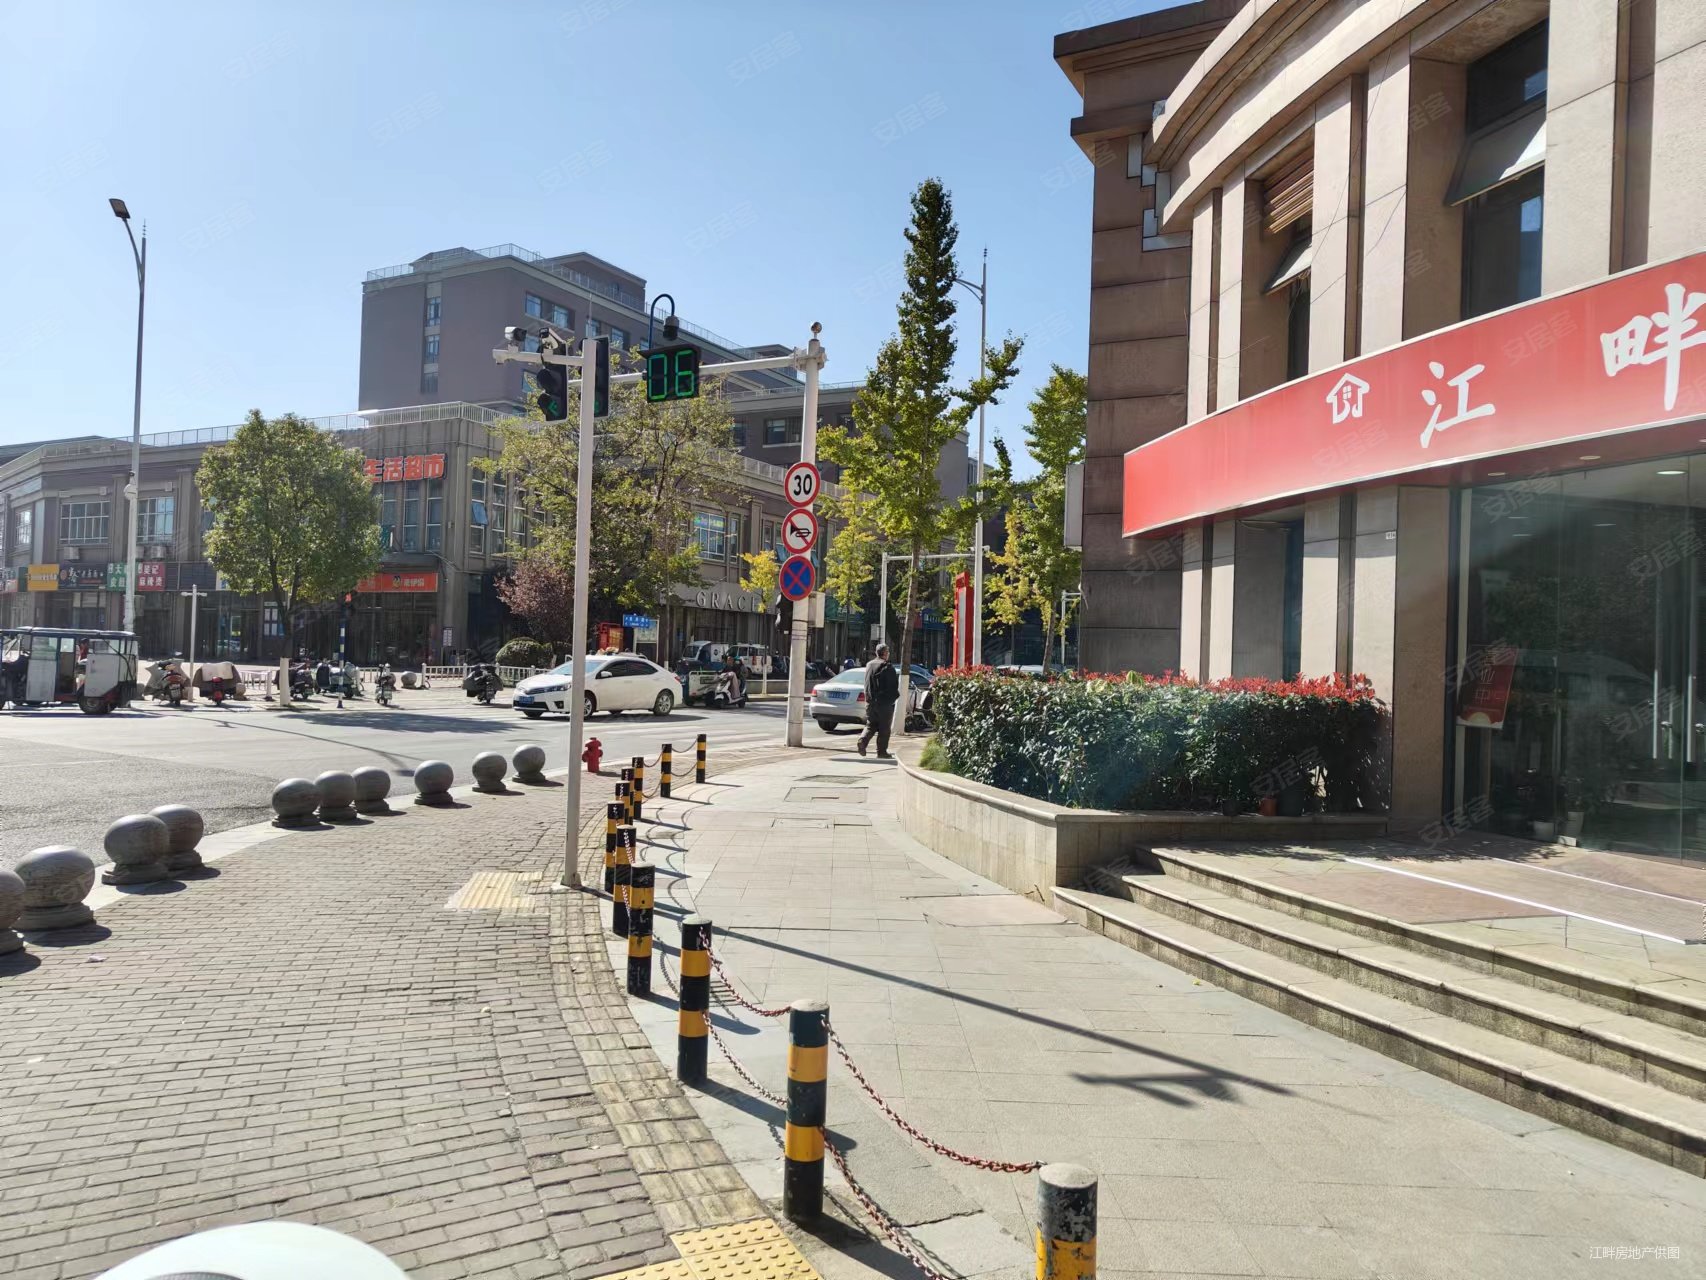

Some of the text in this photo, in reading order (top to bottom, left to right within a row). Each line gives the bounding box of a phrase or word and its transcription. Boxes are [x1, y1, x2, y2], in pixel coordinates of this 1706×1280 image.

[648, 349, 695, 400] 06
[1420, 283, 1706, 448] 江畔
[363, 453, 446, 482] 生活超市
[793, 473, 813, 496] 30
